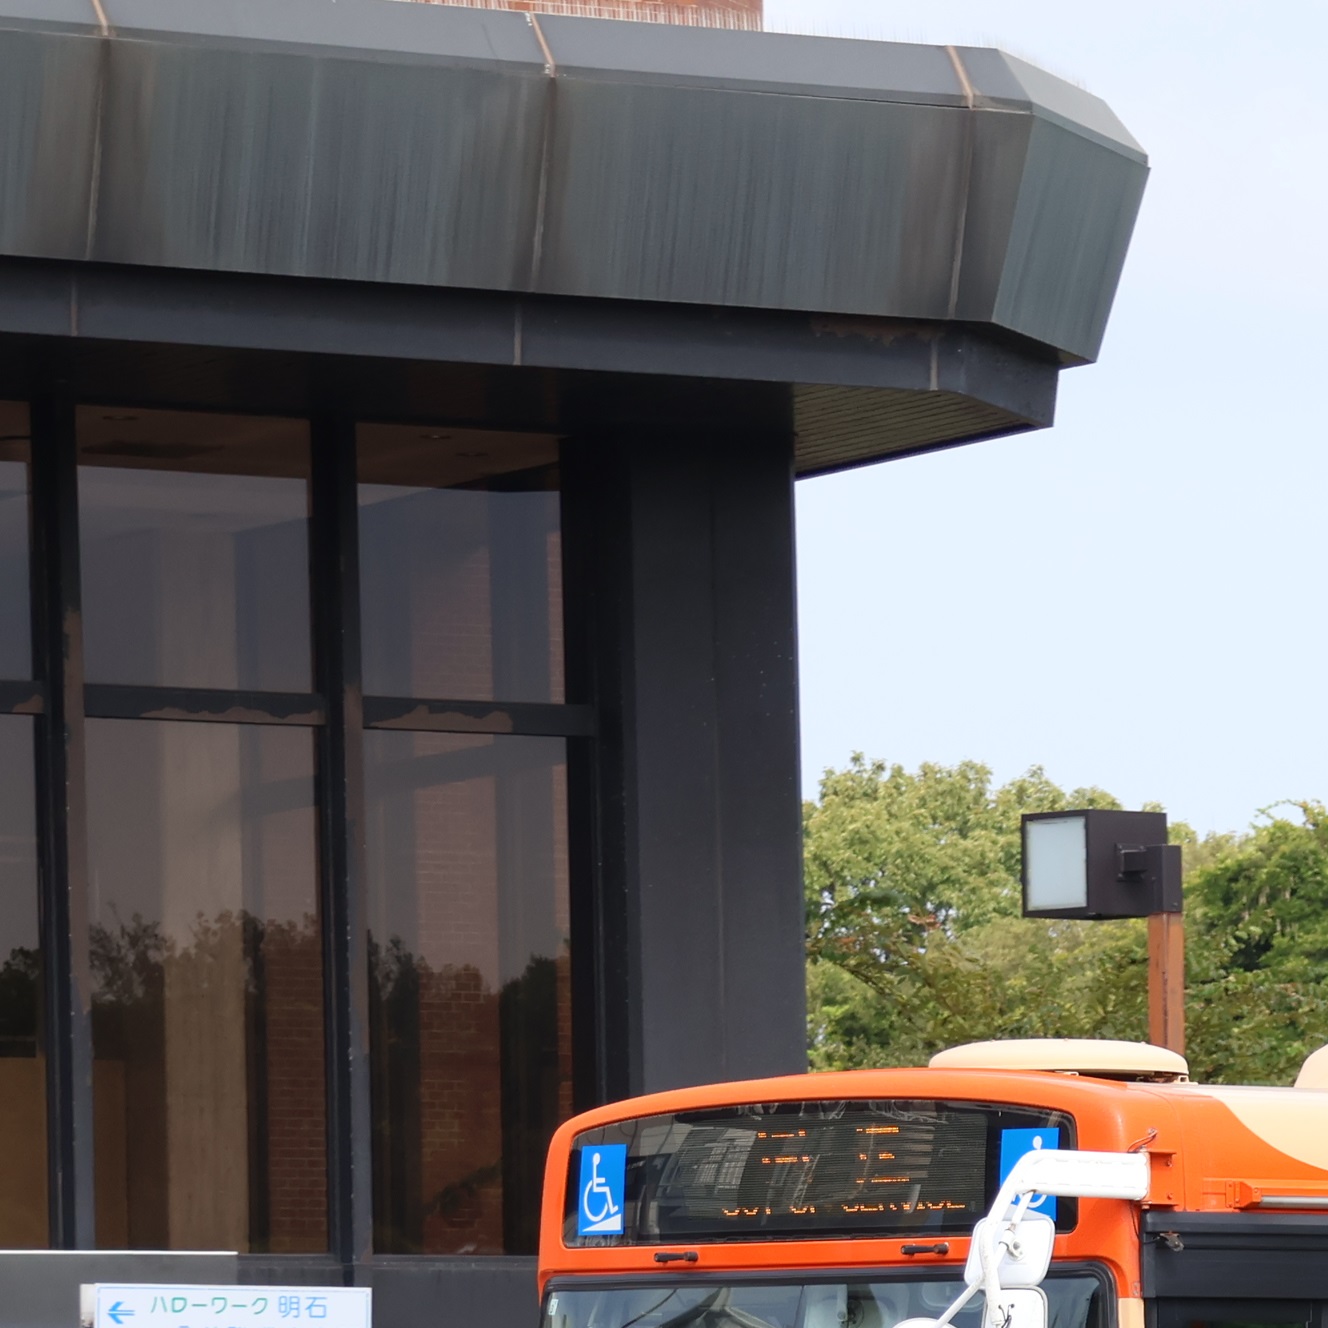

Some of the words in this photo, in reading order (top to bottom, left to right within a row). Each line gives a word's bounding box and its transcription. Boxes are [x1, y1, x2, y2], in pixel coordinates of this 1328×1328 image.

[150, 1296, 269, 1315] ハローワーク
[278, 1296, 328, 1318] 明石
